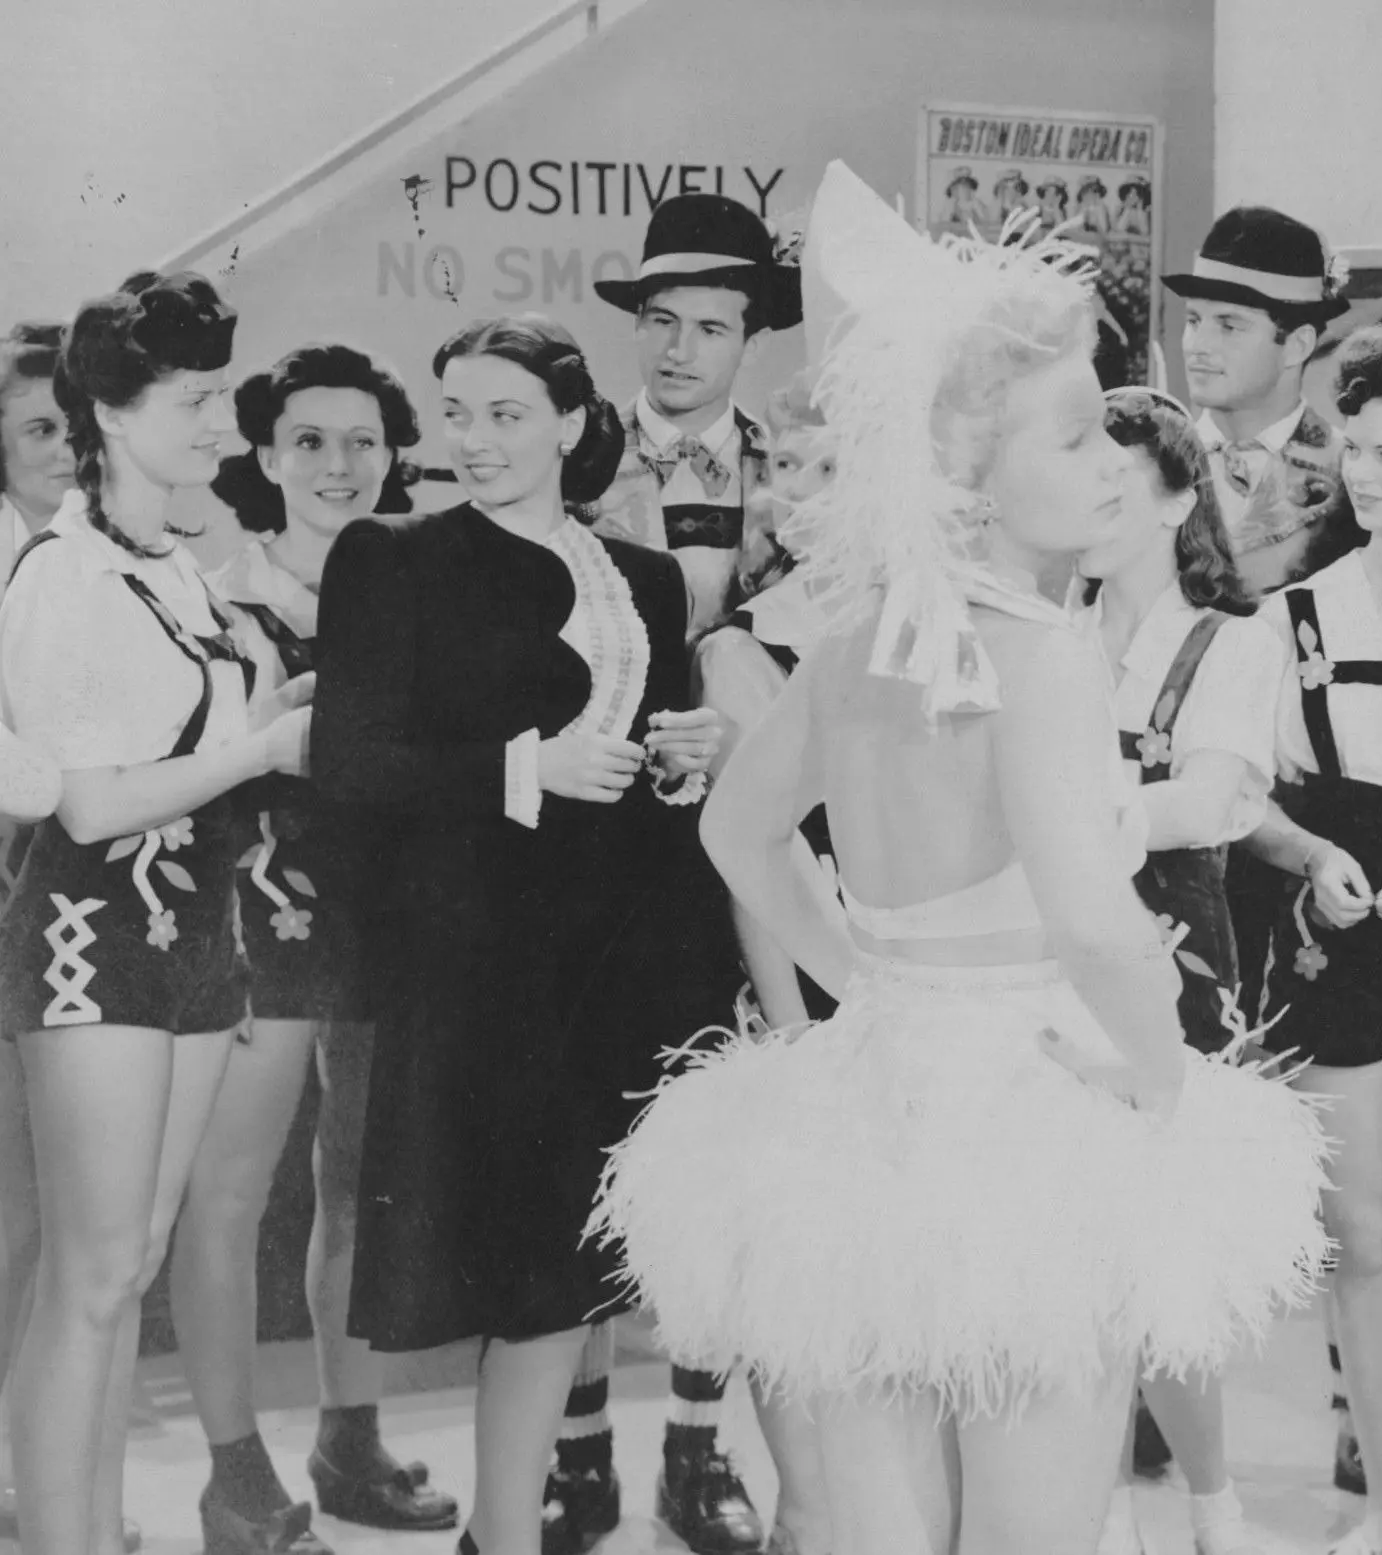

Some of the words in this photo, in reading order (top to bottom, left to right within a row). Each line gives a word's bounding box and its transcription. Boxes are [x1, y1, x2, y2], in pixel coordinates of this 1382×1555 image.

[938, 117, 1012, 156] BOSTON
[1012, 121, 1063, 159] IDEAL
[1067, 125, 1122, 162] OPERA
[376, 241, 465, 300] NO
